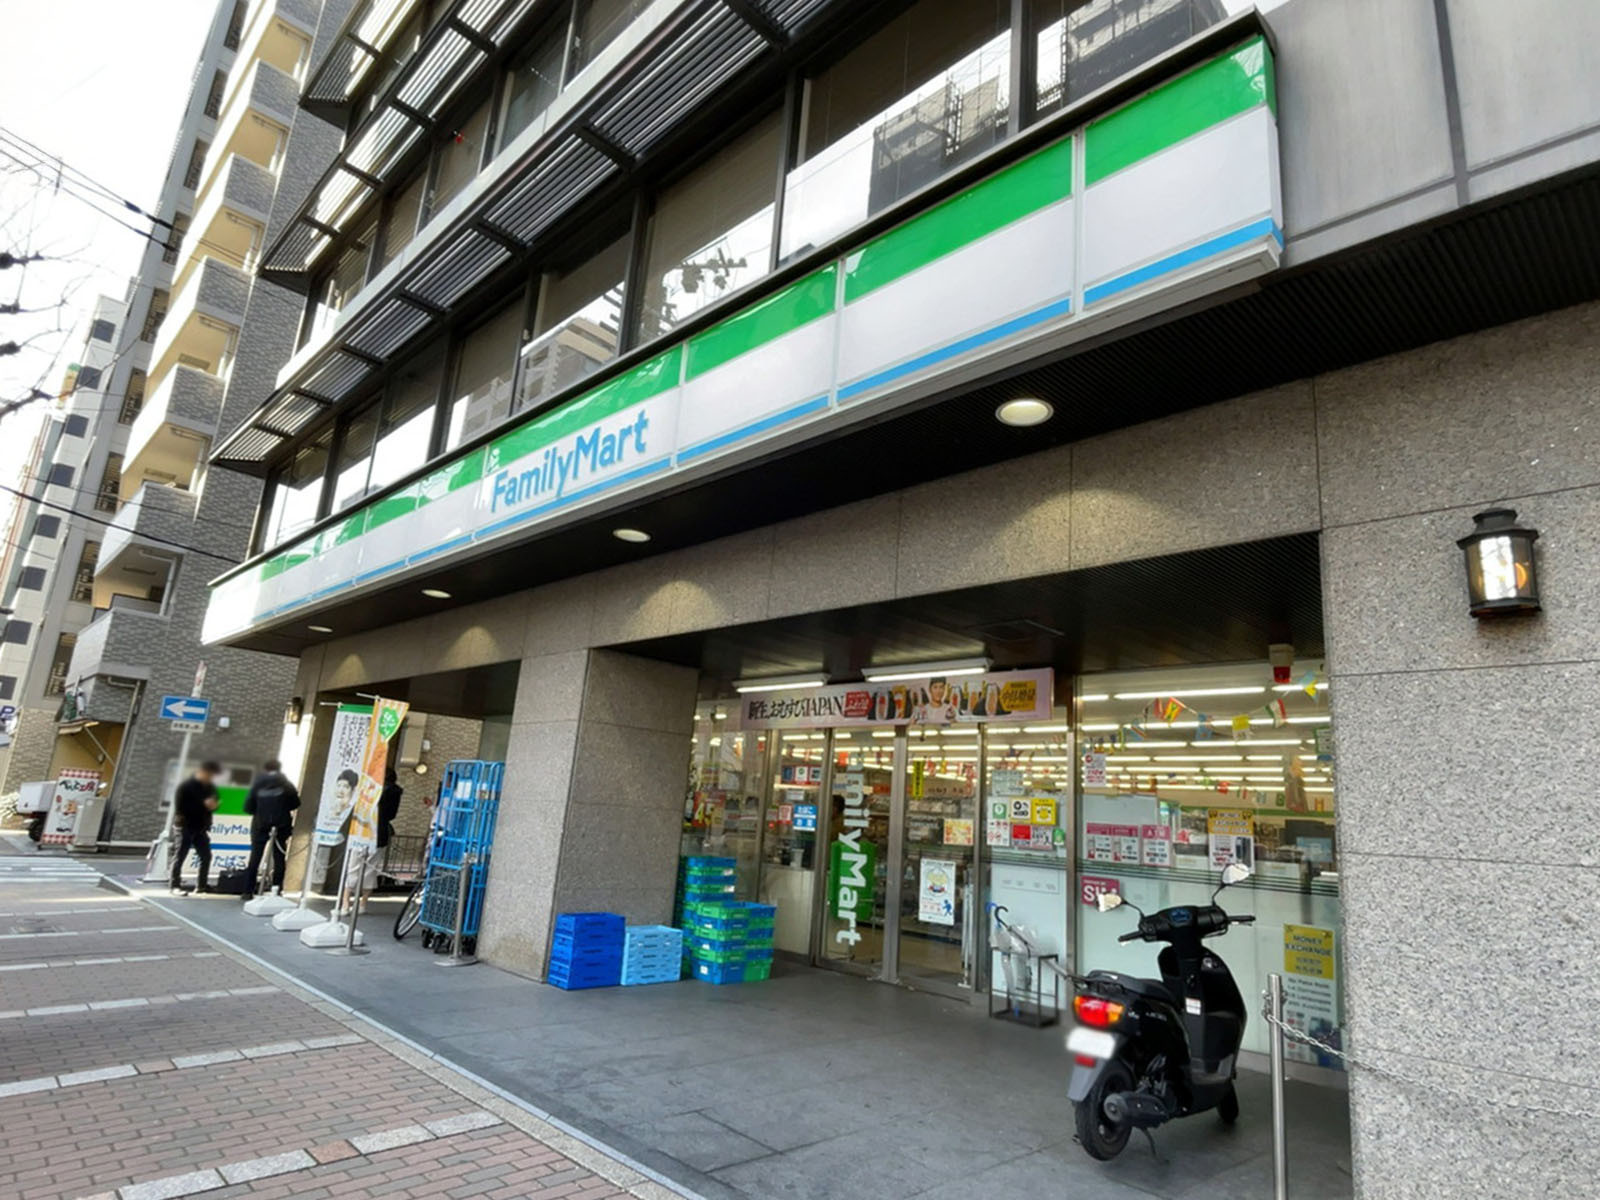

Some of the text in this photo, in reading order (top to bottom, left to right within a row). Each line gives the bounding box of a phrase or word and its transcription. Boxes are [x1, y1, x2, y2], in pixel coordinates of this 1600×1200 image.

[491, 410, 650, 514] FamilyMart
[209, 824, 249, 836] milyMa
[836, 752, 870, 947] milyMart
[213, 855, 247, 868] たばこ
[1083, 884, 1117, 902] SI
